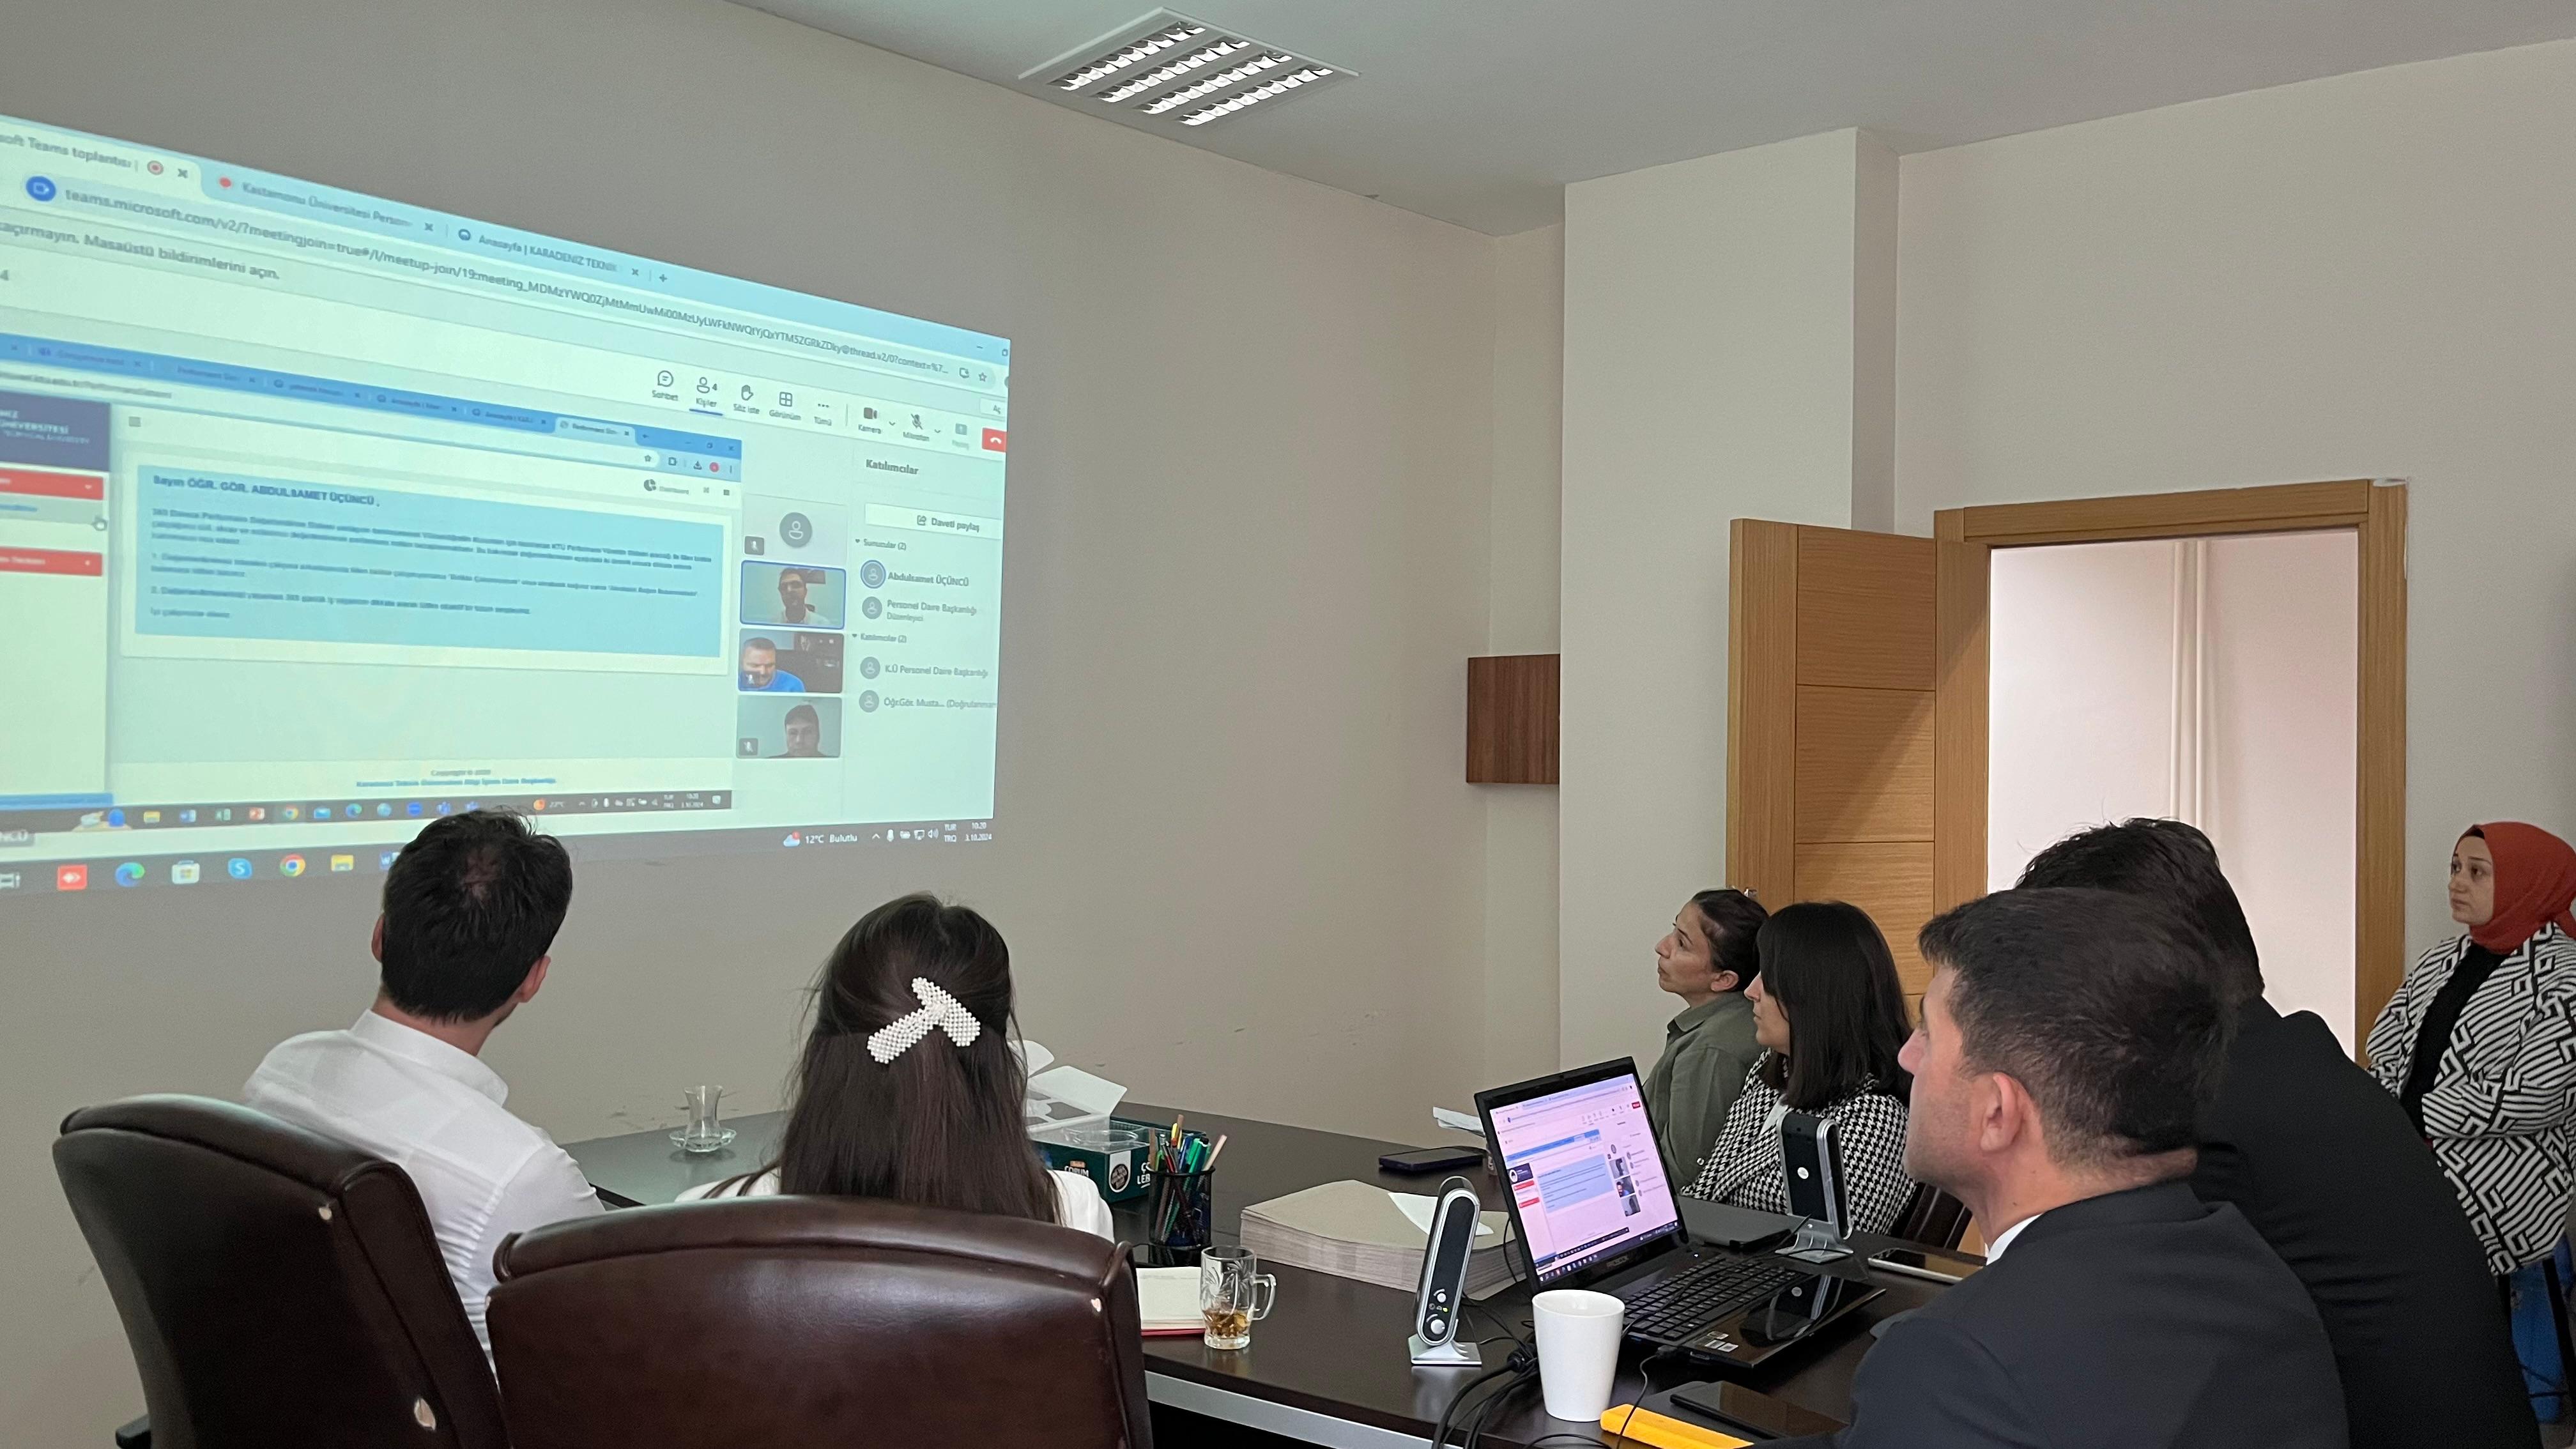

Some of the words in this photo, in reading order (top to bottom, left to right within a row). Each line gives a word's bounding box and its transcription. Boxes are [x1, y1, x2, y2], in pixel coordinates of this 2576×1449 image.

[28, 136, 69, 155] Teams
[84, 234, 154, 257] Masaüstü
[158, 247, 245, 273] bildirimlerini
[866, 459, 919, 475] Katılımcılar
[888, 572, 934, 584] Abdulsamet
[936, 574, 969, 587] ÜÇÜNCÜ
[806, 834, 824, 843] 12°C
[829, 834, 857, 843] Bulutlu
